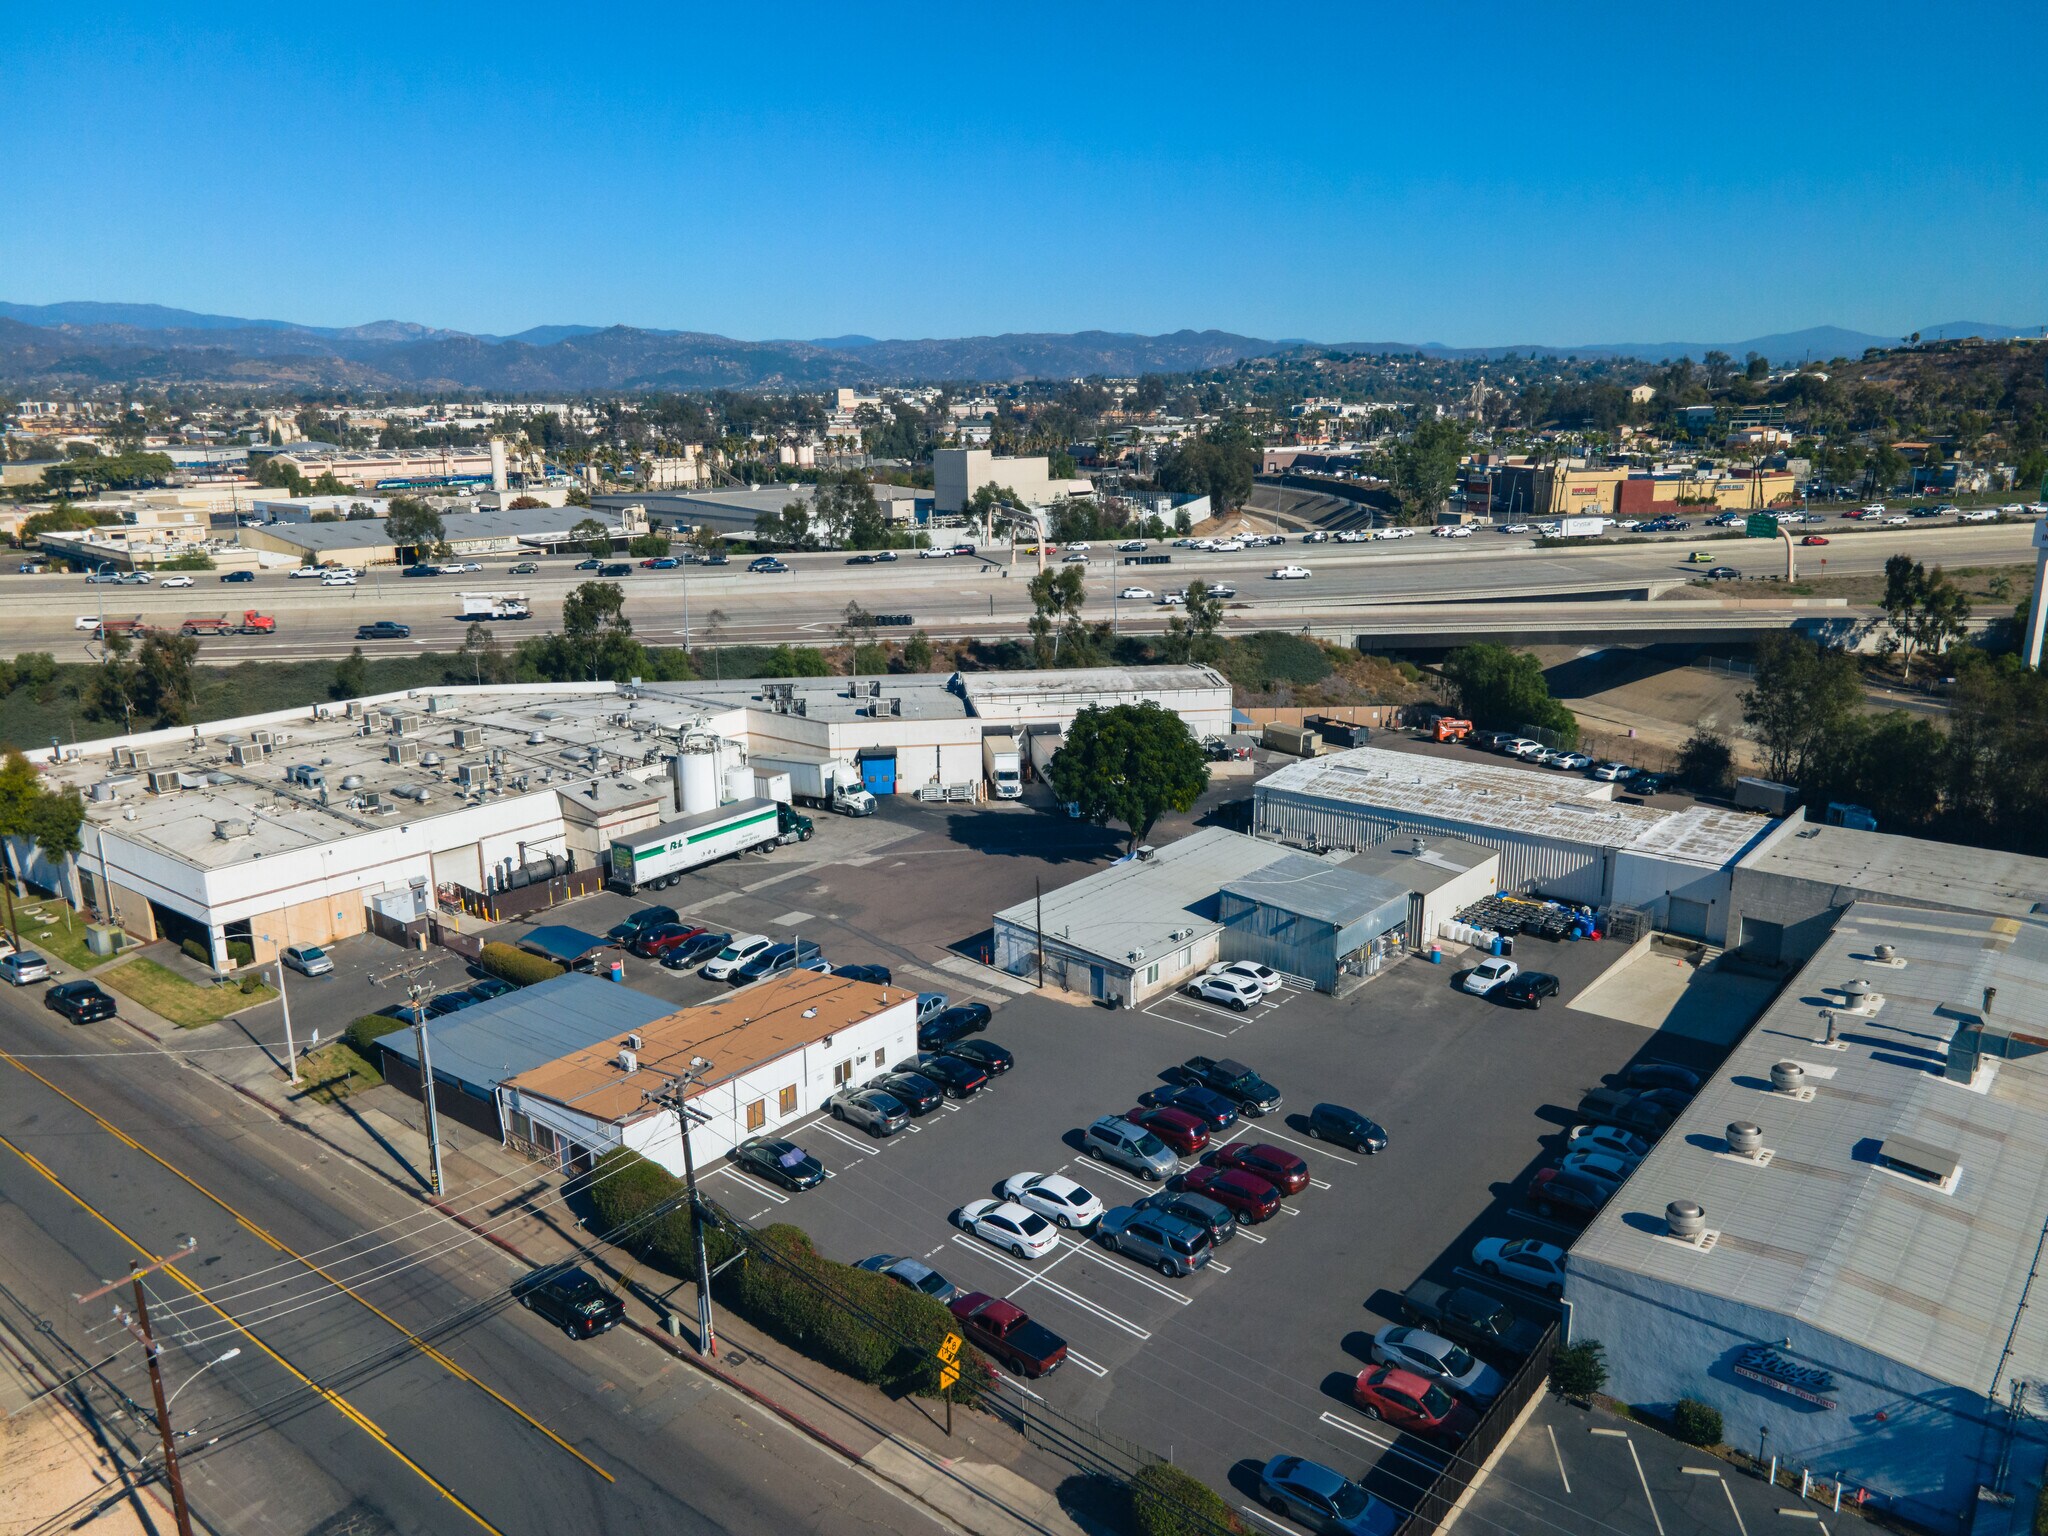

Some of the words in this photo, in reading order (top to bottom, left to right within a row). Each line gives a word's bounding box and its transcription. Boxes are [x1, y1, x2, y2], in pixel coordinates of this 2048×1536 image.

[1736, 1367, 1759, 1380] AUTO
[1761, 1376, 1784, 1391] BODY
[1794, 1389, 1835, 1410] PAINTING
